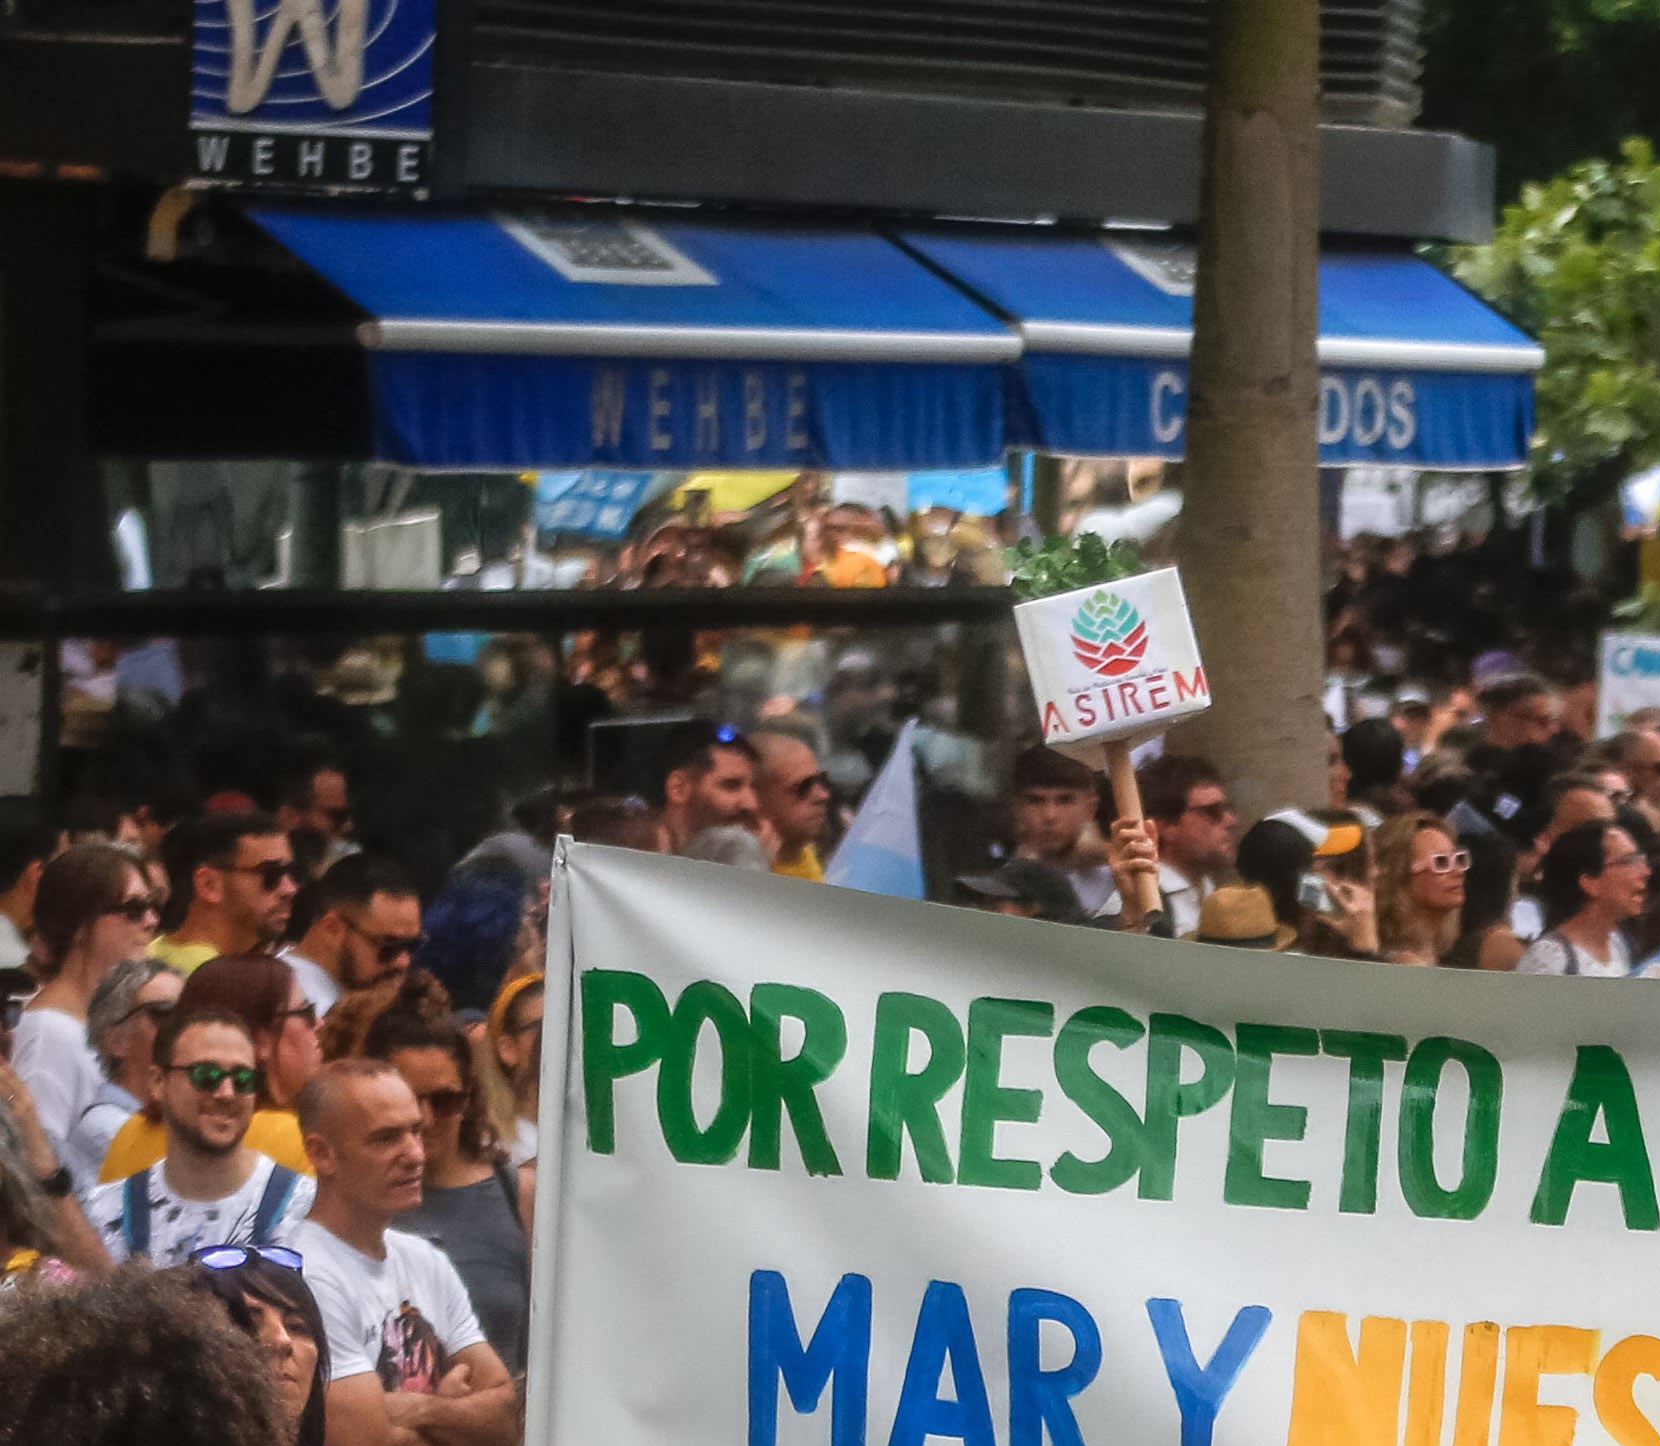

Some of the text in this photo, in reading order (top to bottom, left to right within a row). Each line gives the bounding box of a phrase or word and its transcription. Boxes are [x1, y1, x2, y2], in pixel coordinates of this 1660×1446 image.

[197, 135, 422, 183] WEHBE
[592, 373, 807, 452] WEHBE
[1040, 665, 1212, 739] ASIREM
[581, 967, 848, 1178] POR
[866, 990, 1503, 1221] RESPETO
[1529, 1043, 1660, 1231] A
